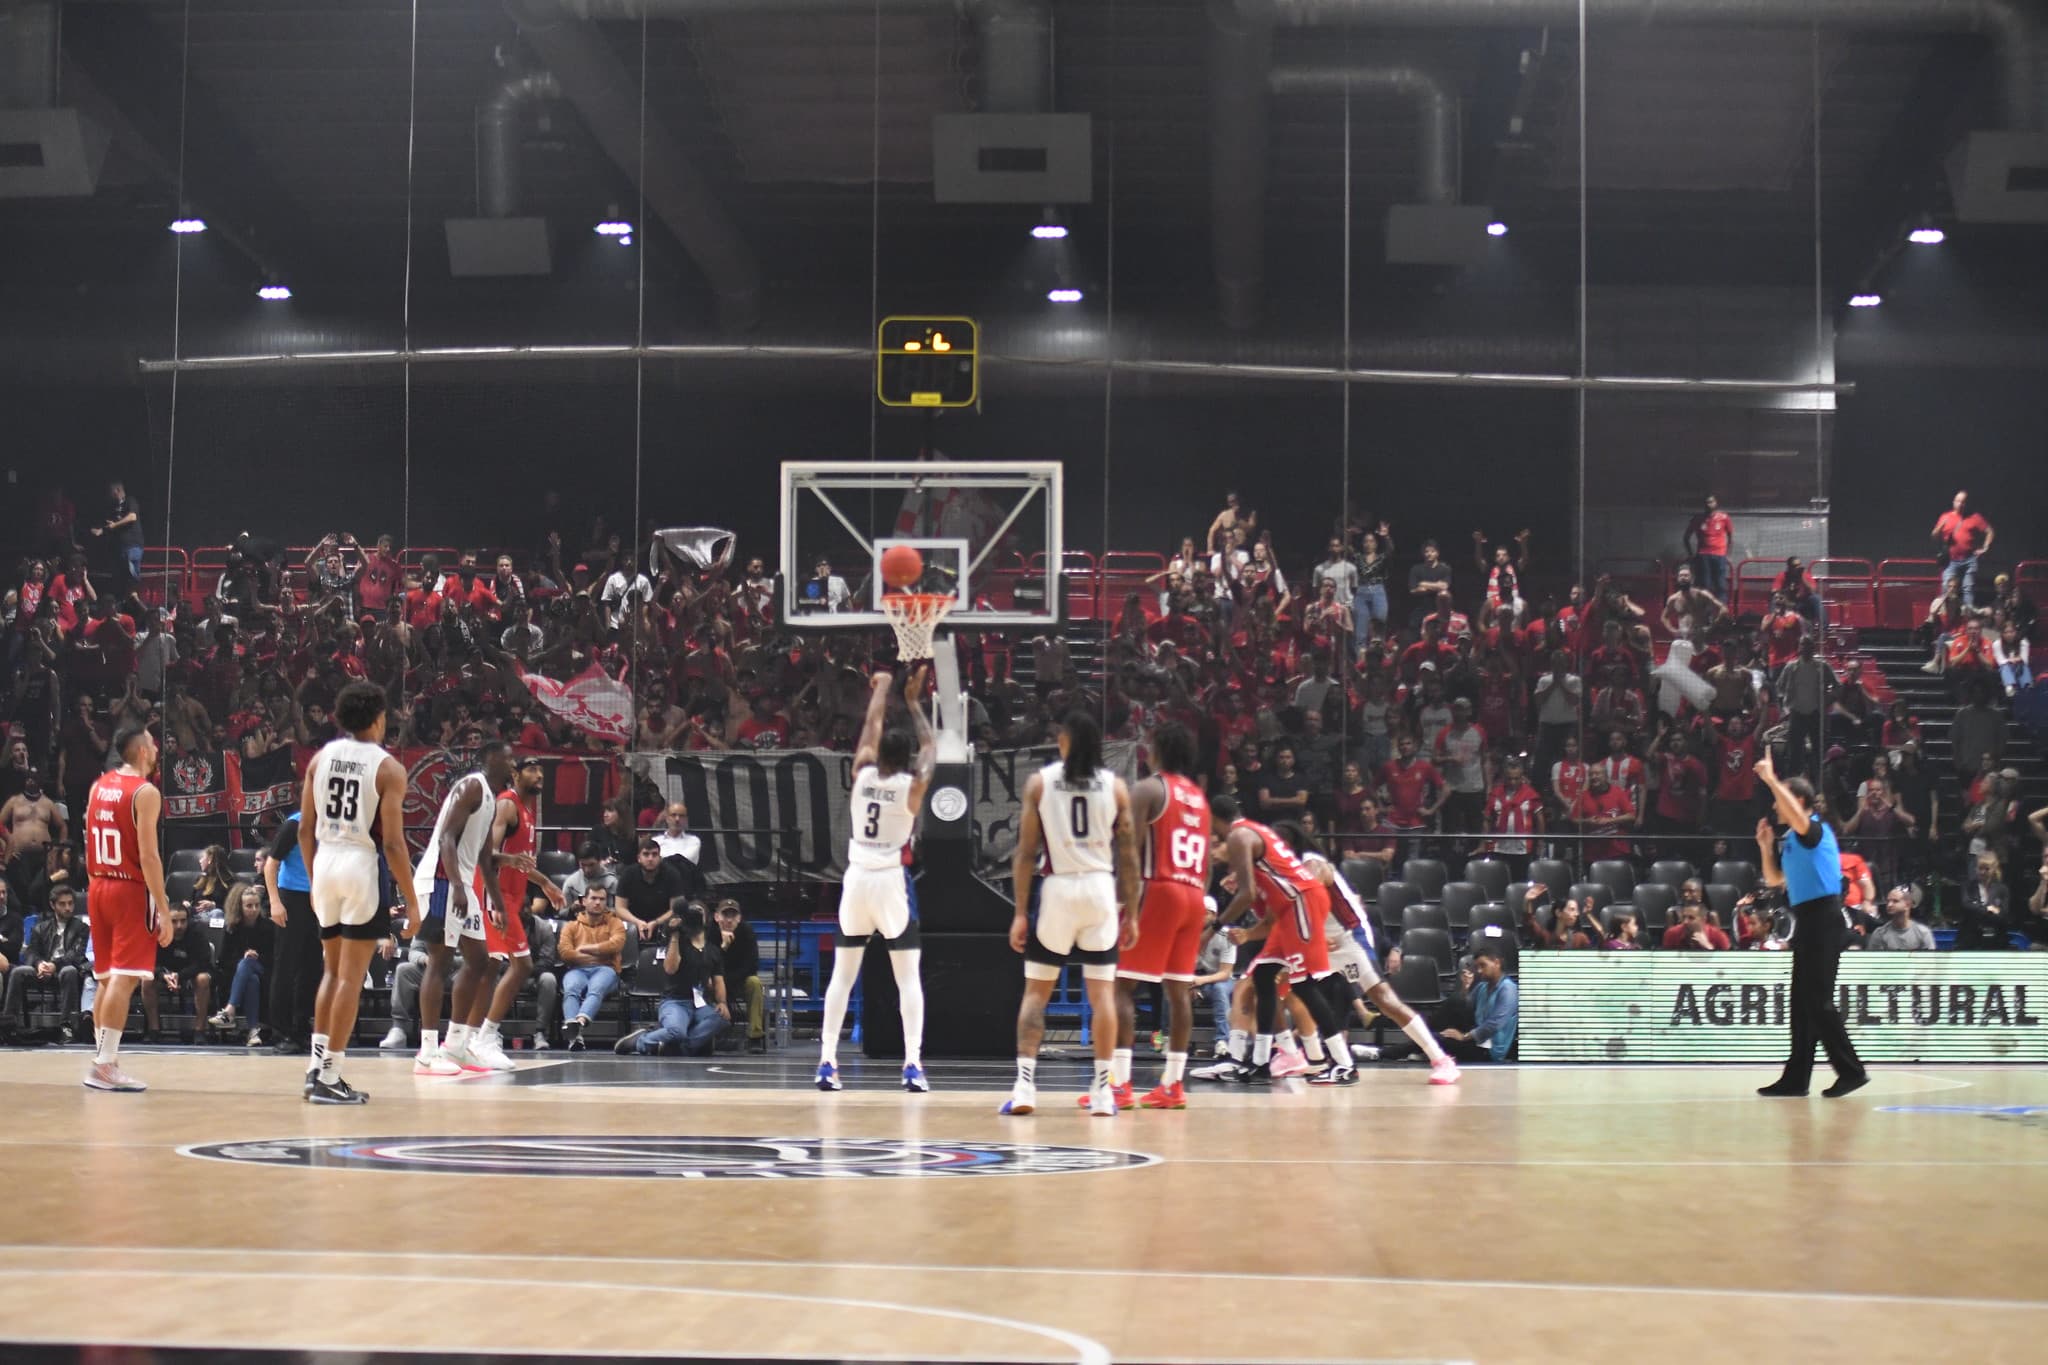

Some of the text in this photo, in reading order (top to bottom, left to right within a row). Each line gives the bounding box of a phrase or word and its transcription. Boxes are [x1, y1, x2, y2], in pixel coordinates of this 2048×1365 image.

[326, 776, 360, 822] 33
[864, 802, 880, 838] 3
[1071, 795, 1089, 839] 0
[92, 826, 122, 866] 10
[1172, 828, 1205, 873] 69
[1670, 983, 2039, 1026] AGRILTURAL
